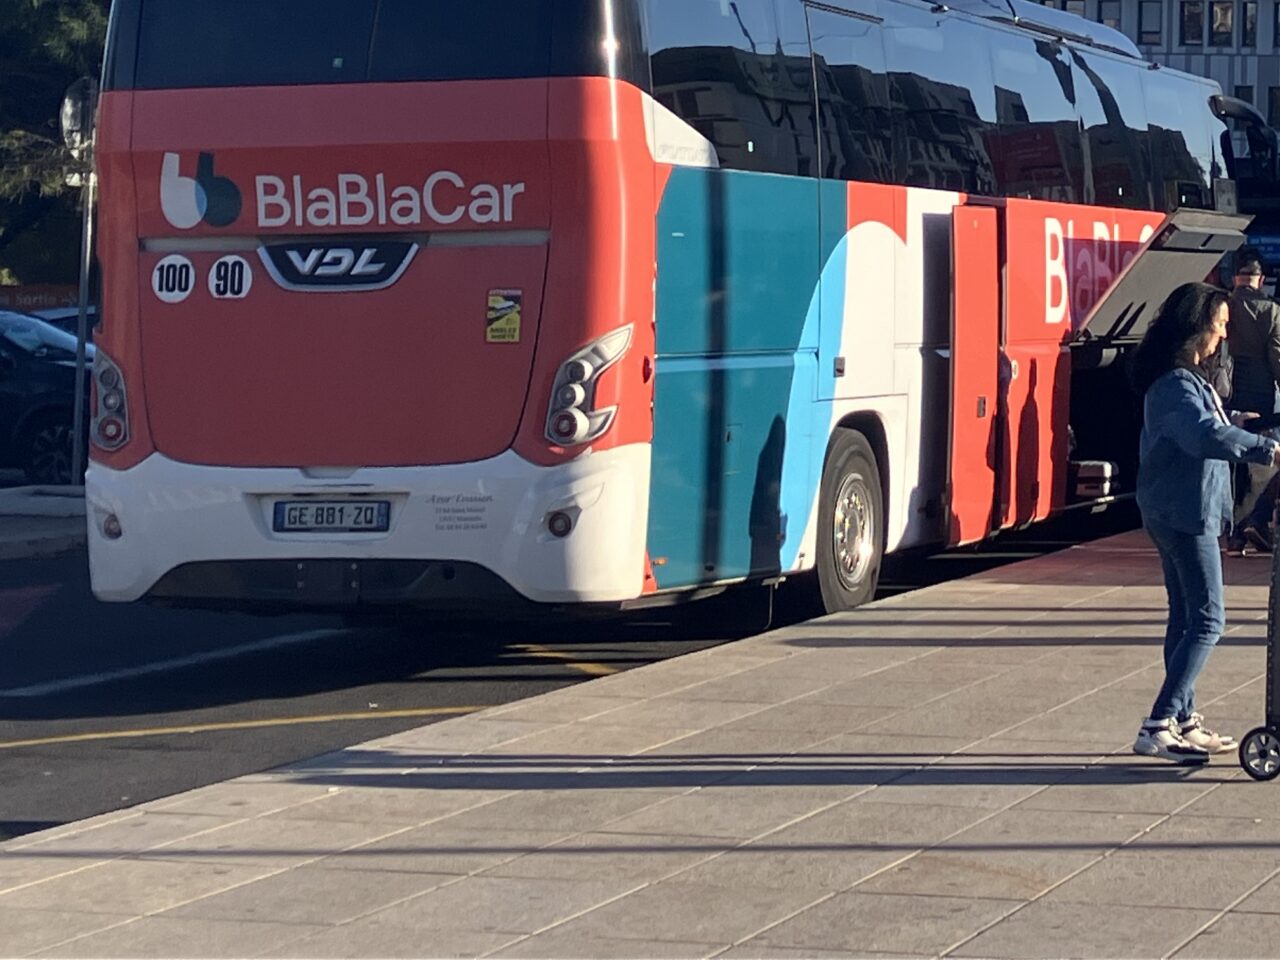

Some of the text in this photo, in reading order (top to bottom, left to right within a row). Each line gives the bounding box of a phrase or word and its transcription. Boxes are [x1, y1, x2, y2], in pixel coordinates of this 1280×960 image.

[255, 169, 526, 228] BlaBlaCar
[155, 262, 191, 294] 100
[214, 260, 245, 297] 90
[284, 246, 387, 277] VDL
